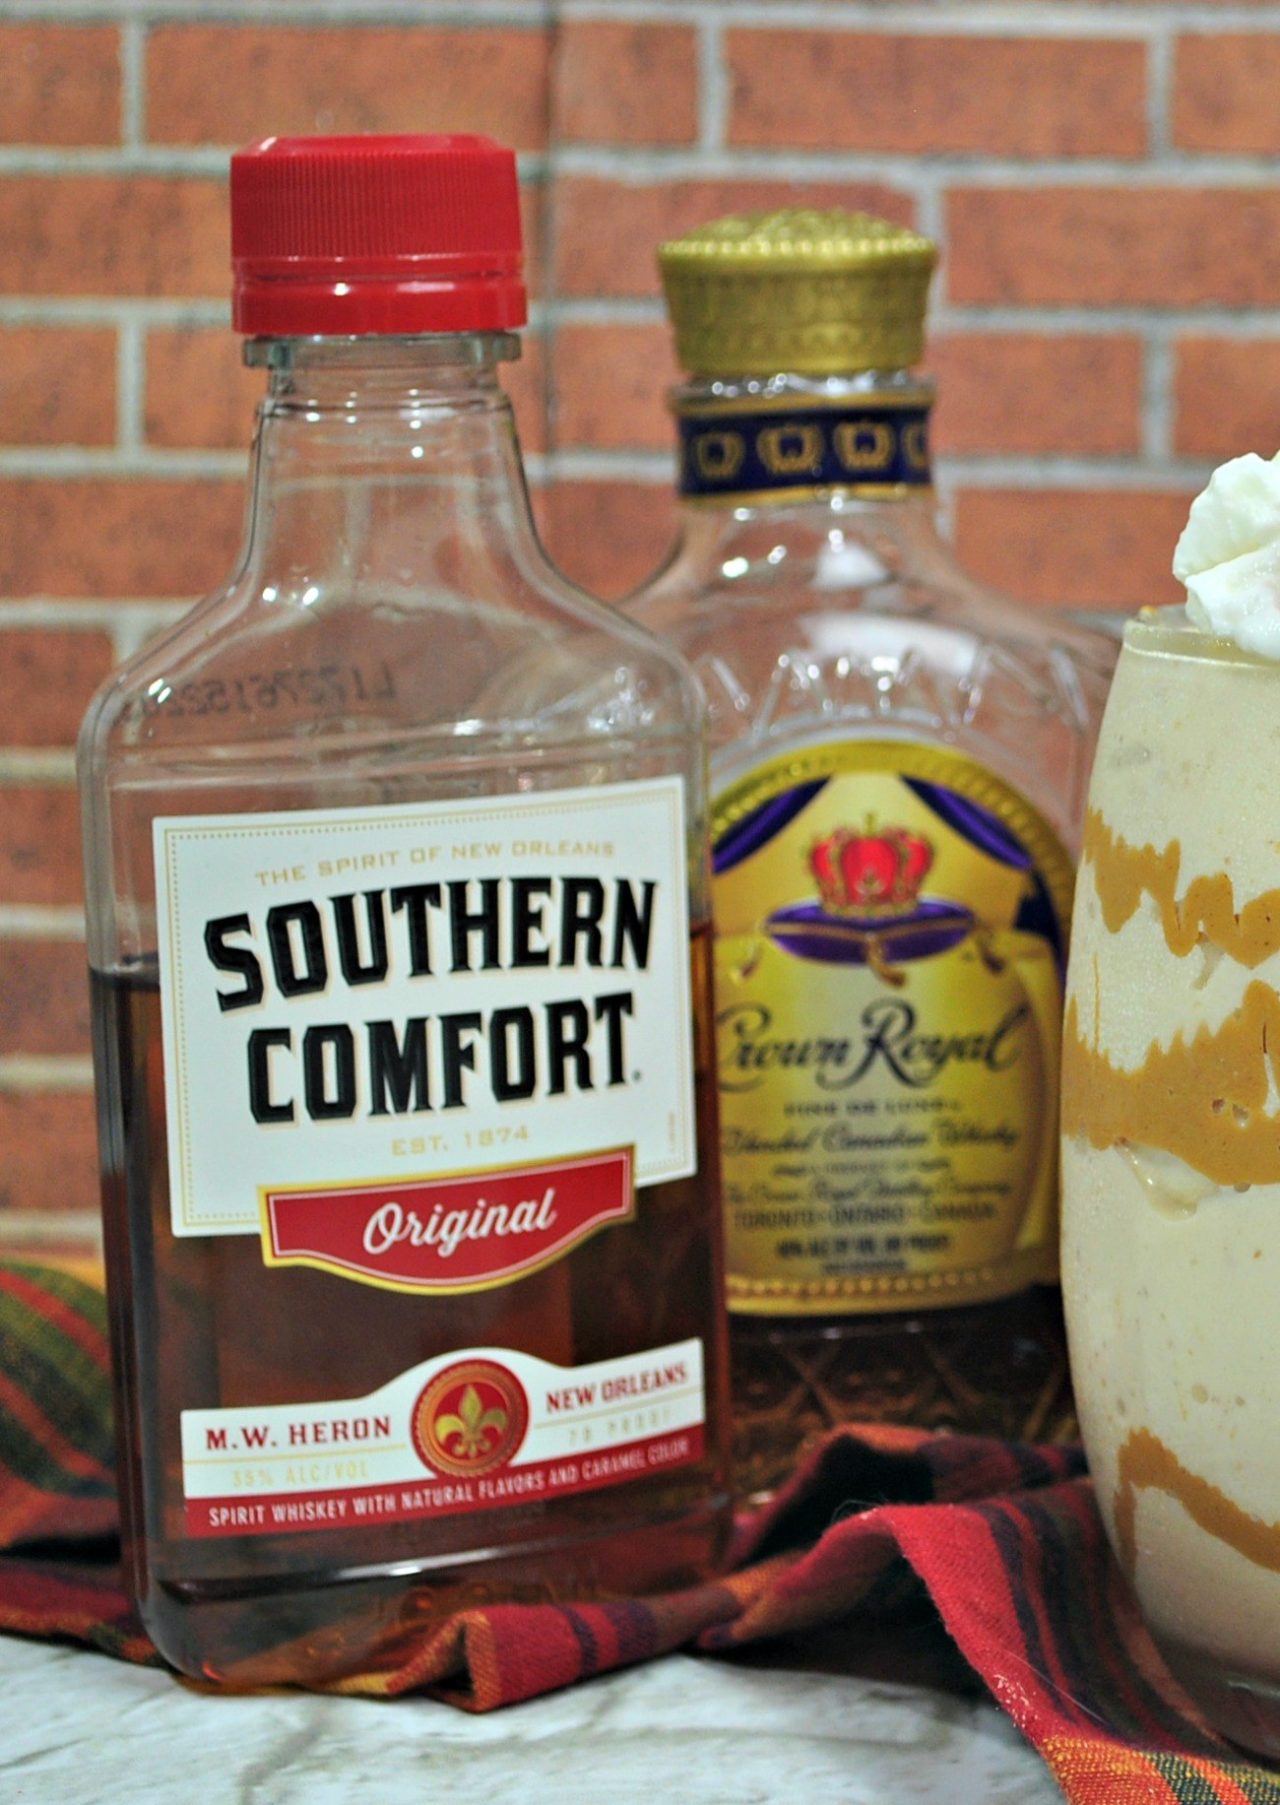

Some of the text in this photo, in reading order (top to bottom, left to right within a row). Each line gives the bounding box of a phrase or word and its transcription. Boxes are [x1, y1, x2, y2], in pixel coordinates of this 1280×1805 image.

[255, 840, 615, 887] THE SPIRIT OF NEW ORLEANS
[203, 875, 658, 1014] SOUTHERN
[716, 997, 1032, 1093] Crown Royal
[391, 1125, 531, 1157] EST. 1874
[362, 1187, 557, 1258] Original
[546, 1361, 688, 1415] NEW ORLEANS
[205, 1415, 392, 1451] M.W. HERON
[209, 1438, 690, 1527] SPIRIT WHISKEY WITH NATURAL FLAVORS AND CARAMEL COLOR
